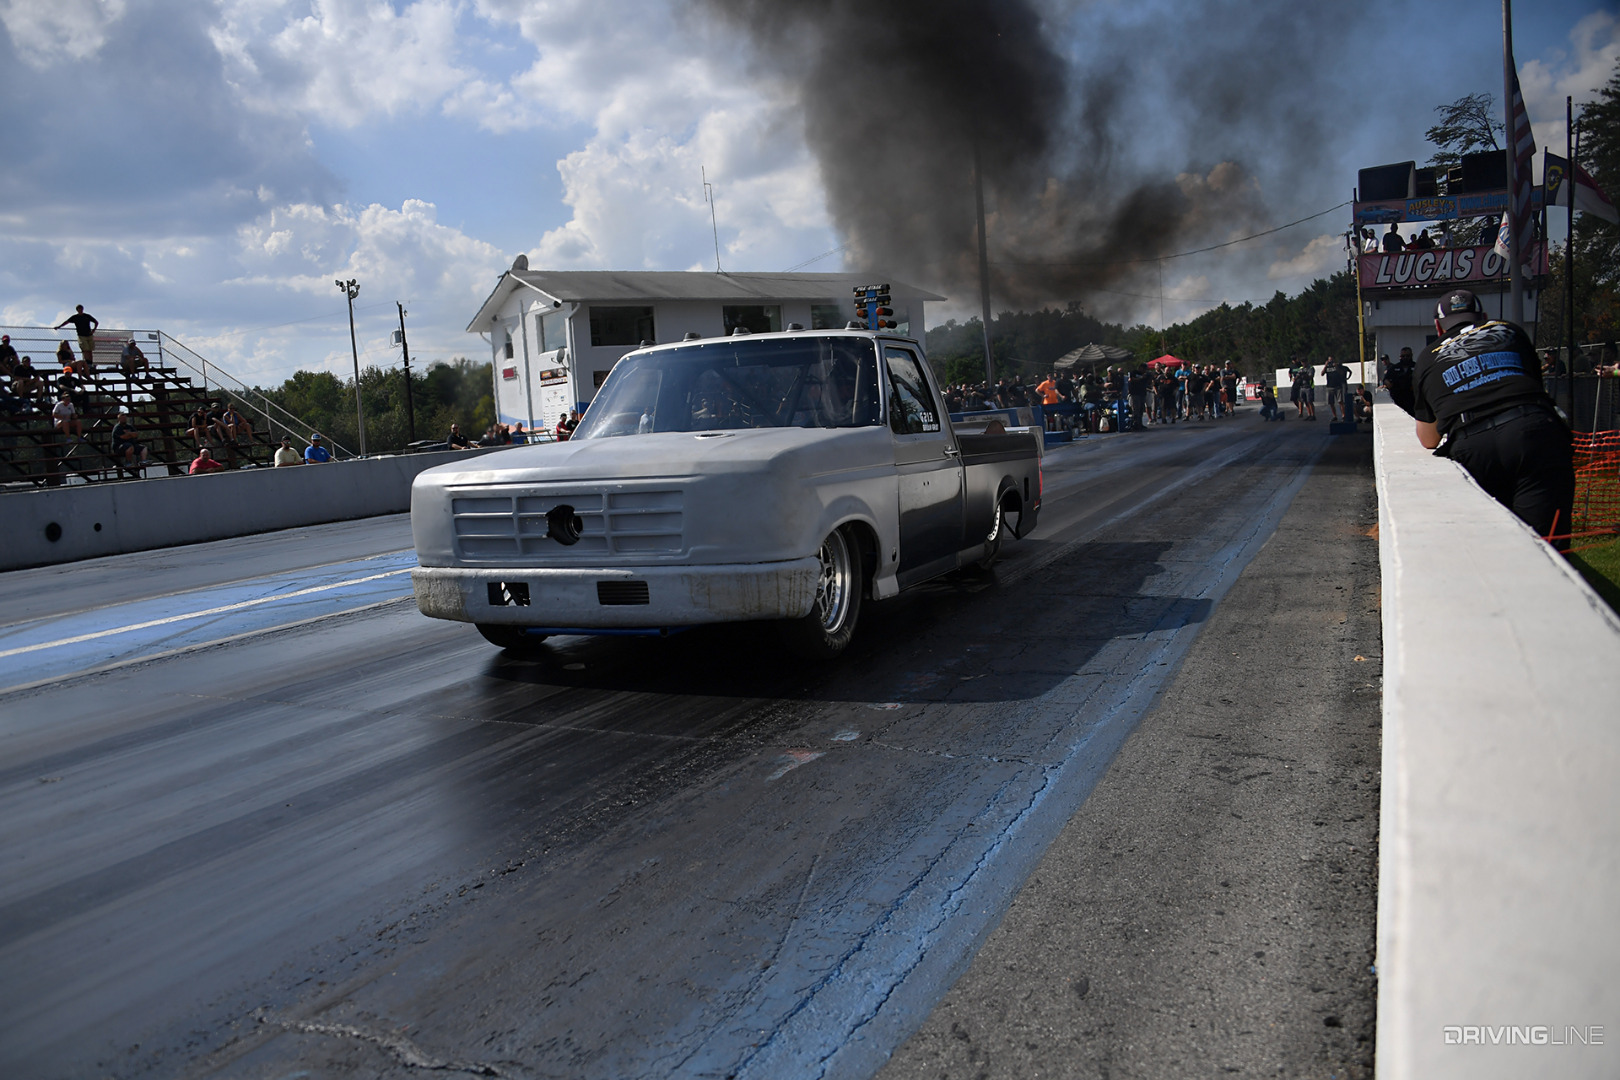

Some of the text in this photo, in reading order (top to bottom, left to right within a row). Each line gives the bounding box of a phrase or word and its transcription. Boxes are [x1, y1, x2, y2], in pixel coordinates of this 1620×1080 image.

[1408, 198, 1455, 213] AUSLEY'S
[1375, 248, 1476, 284] LUCAS
[1442, 351, 1524, 388] AUTO FOCUS PHOTOG
